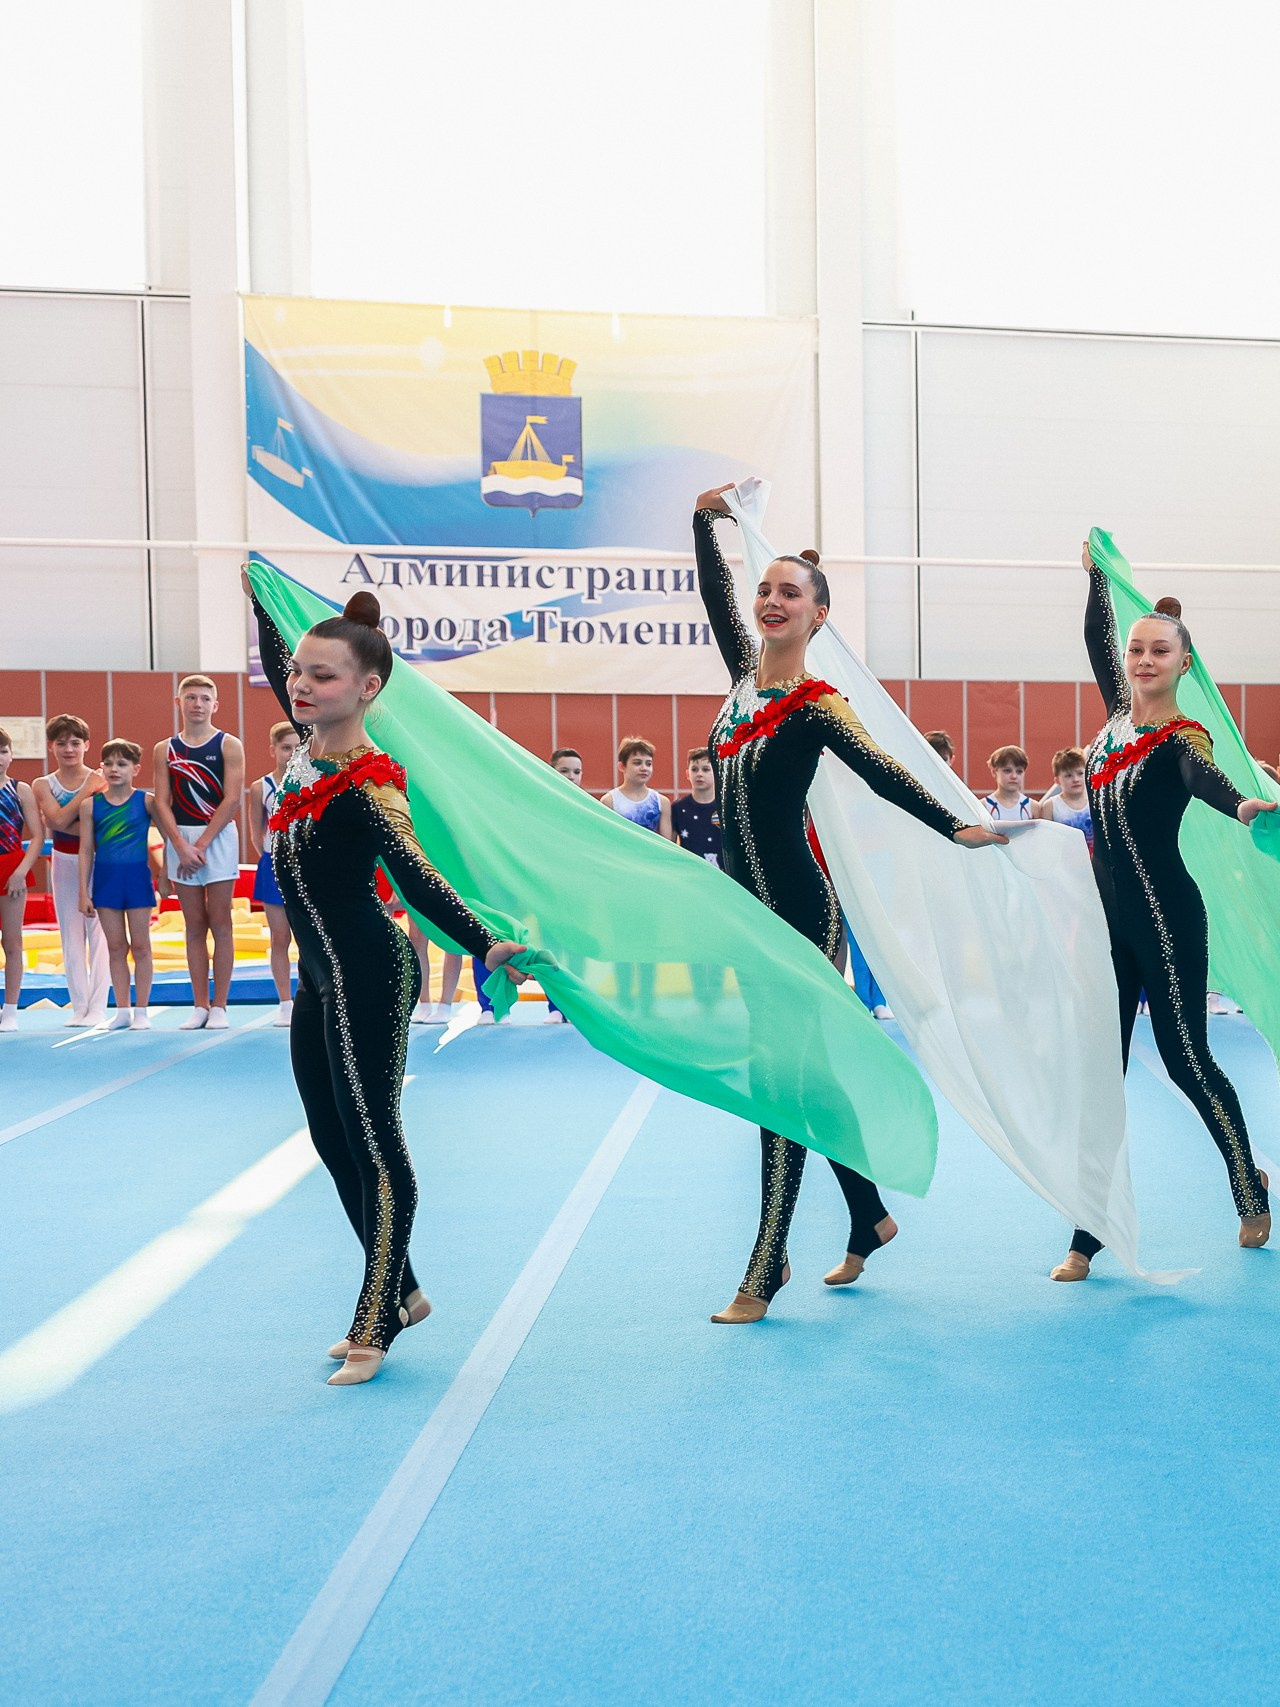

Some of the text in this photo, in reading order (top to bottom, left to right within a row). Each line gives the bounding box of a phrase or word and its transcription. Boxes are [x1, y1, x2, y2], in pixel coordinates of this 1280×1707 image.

[340, 553, 695, 600] Администраци
[380, 610, 712, 651] орода Тюмени
